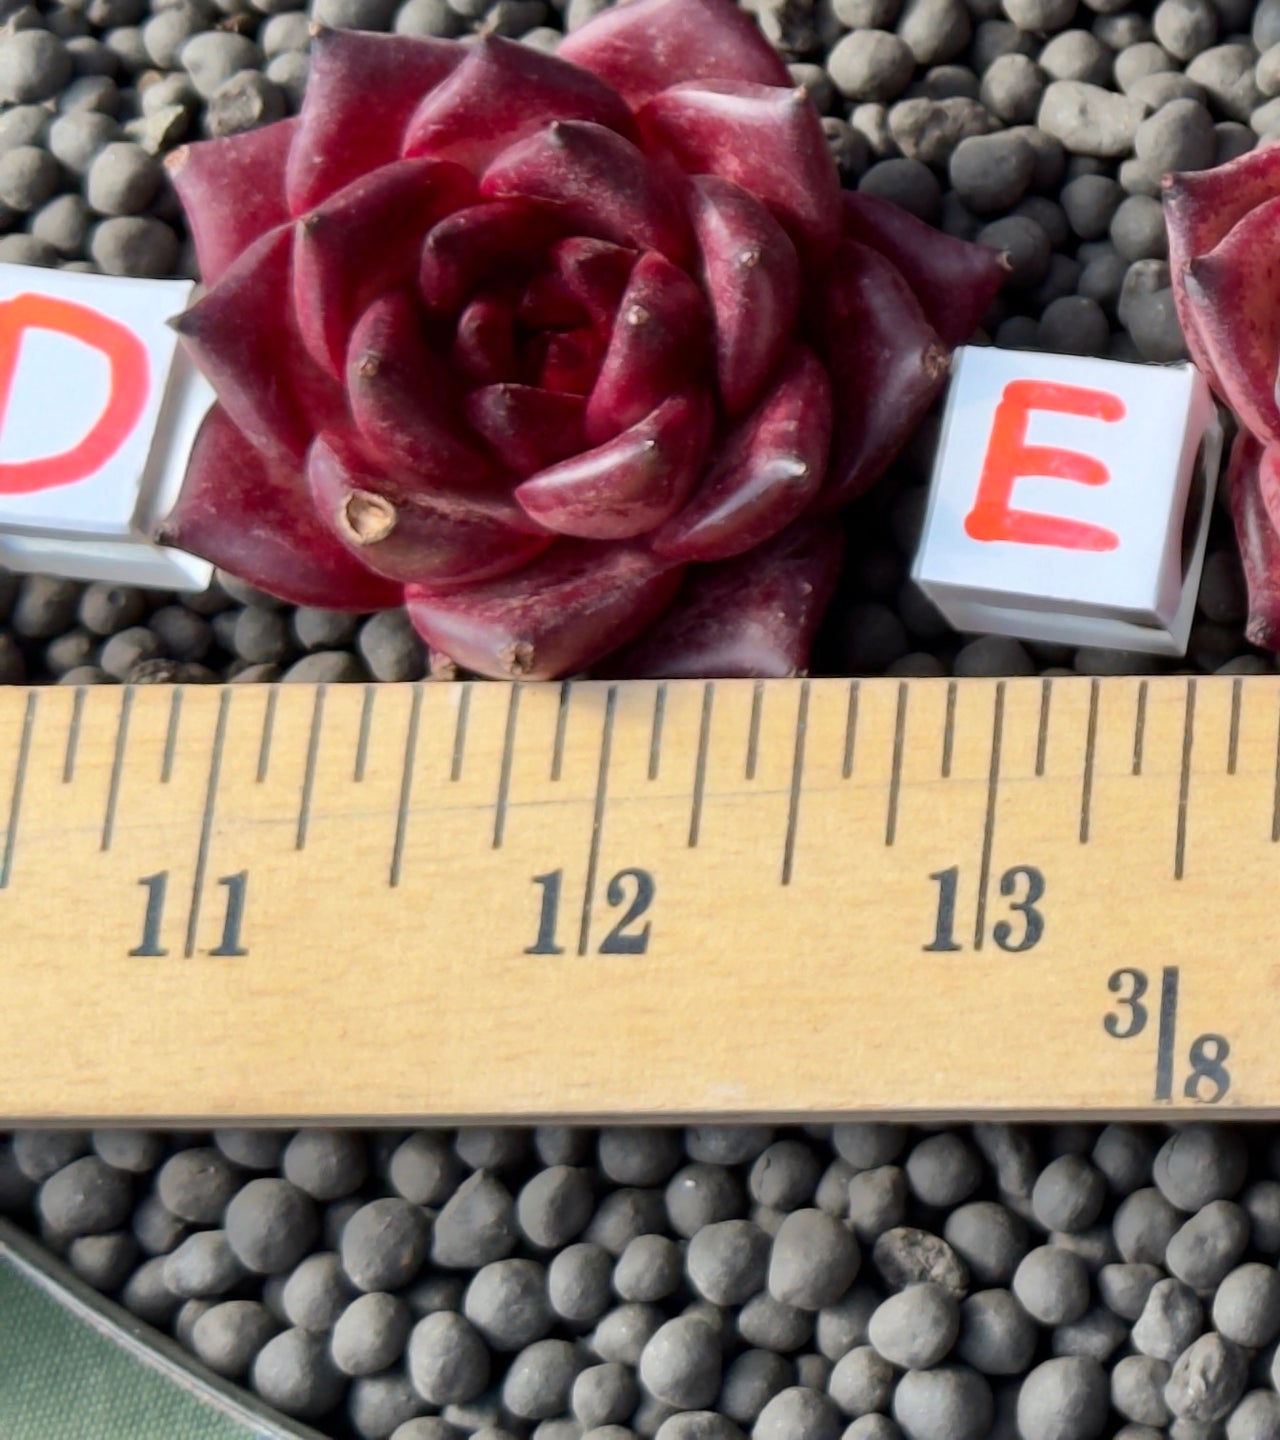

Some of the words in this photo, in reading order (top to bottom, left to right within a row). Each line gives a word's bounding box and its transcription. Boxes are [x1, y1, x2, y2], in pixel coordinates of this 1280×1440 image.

[0, 291, 150, 496] D
[963, 380, 1126, 550] E
[127, 869, 249, 959] 11
[524, 867, 656, 956] 12
[921, 866, 1046, 953] 13
